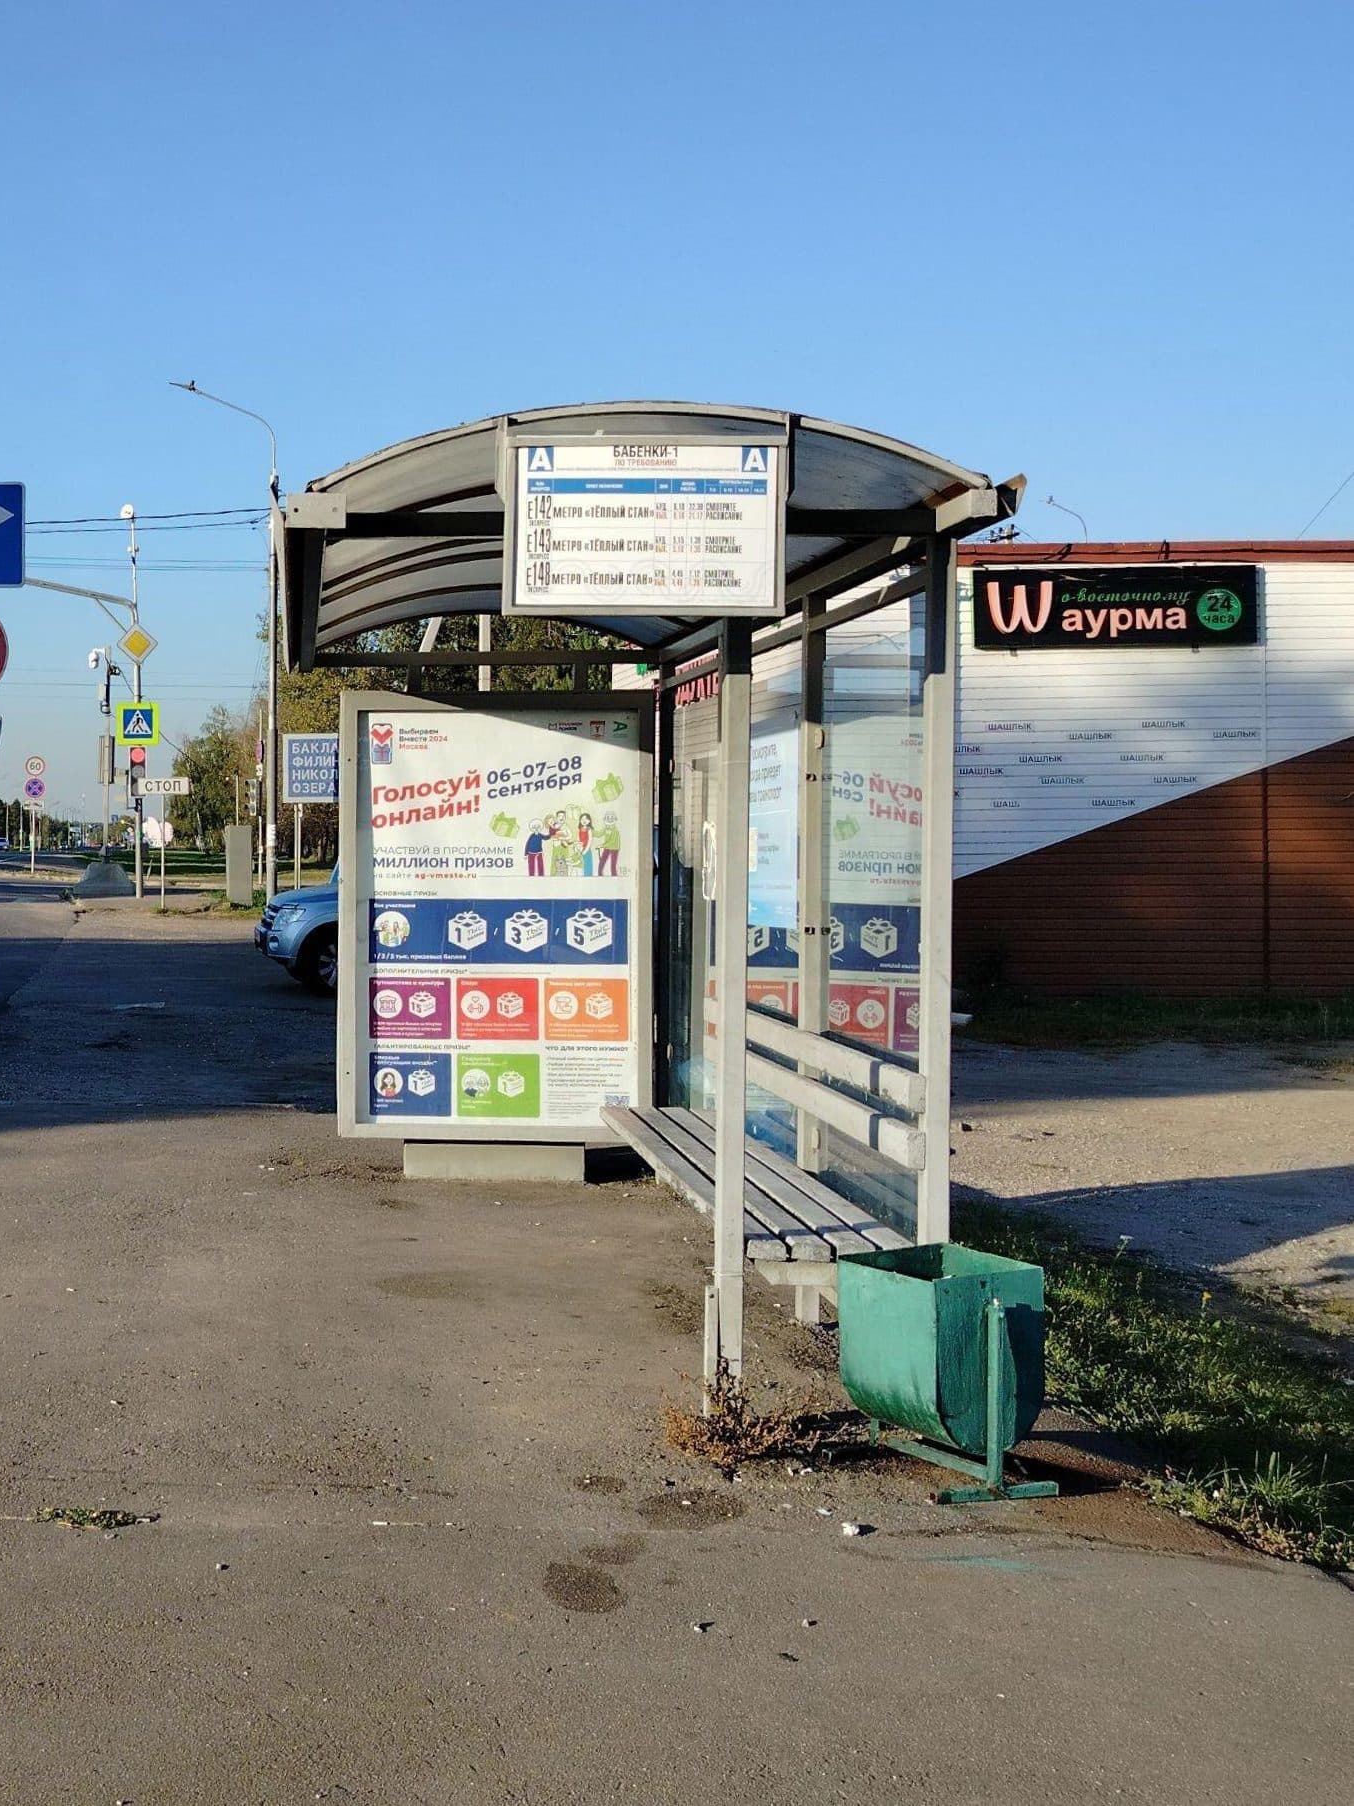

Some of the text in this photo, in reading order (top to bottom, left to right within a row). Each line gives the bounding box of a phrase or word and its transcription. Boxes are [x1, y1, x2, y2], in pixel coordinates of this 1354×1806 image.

[613, 445, 678, 457] БАБЕНКИ-1
[553, 506, 583, 518] МЕТРО
[552, 539, 582, 551] МЕТРО
[551, 573, 581, 584] МЕТРО
[1207, 595, 1234, 613] 24
[1203, 614, 1236, 624] часа
[988, 723, 1032, 731] ШАШЛЫК
[1141, 720, 1186, 728] ШАШЛЫК
[1213, 730, 1257, 738] ШАШЛЫК
[954, 745, 981, 753] ШЛЫК
[1120, 754, 1164, 762] ШАШЛЫК
[959, 767, 1004, 775] ШАШЛЫК
[1041, 777, 1085, 785] ШАШЛЫК
[1153, 775, 1197, 783] ШАШЛЫК
[144, 780, 182, 793] СТОП
[293, 783, 336, 794] ОЗЕРА
[373, 769, 481, 805] Голосуй
[487, 772, 582, 799] сентября
[1092, 799, 1136, 807] ШАШЛЫК
[370, 794, 481, 829] онлайн!
[373, 845, 514, 855] УЧАСТВУЙ В ПРОГРАММЕ
[454, 857, 514, 871] призов
[511, 926, 522, 945] 3
[574, 926, 585, 946] 5
